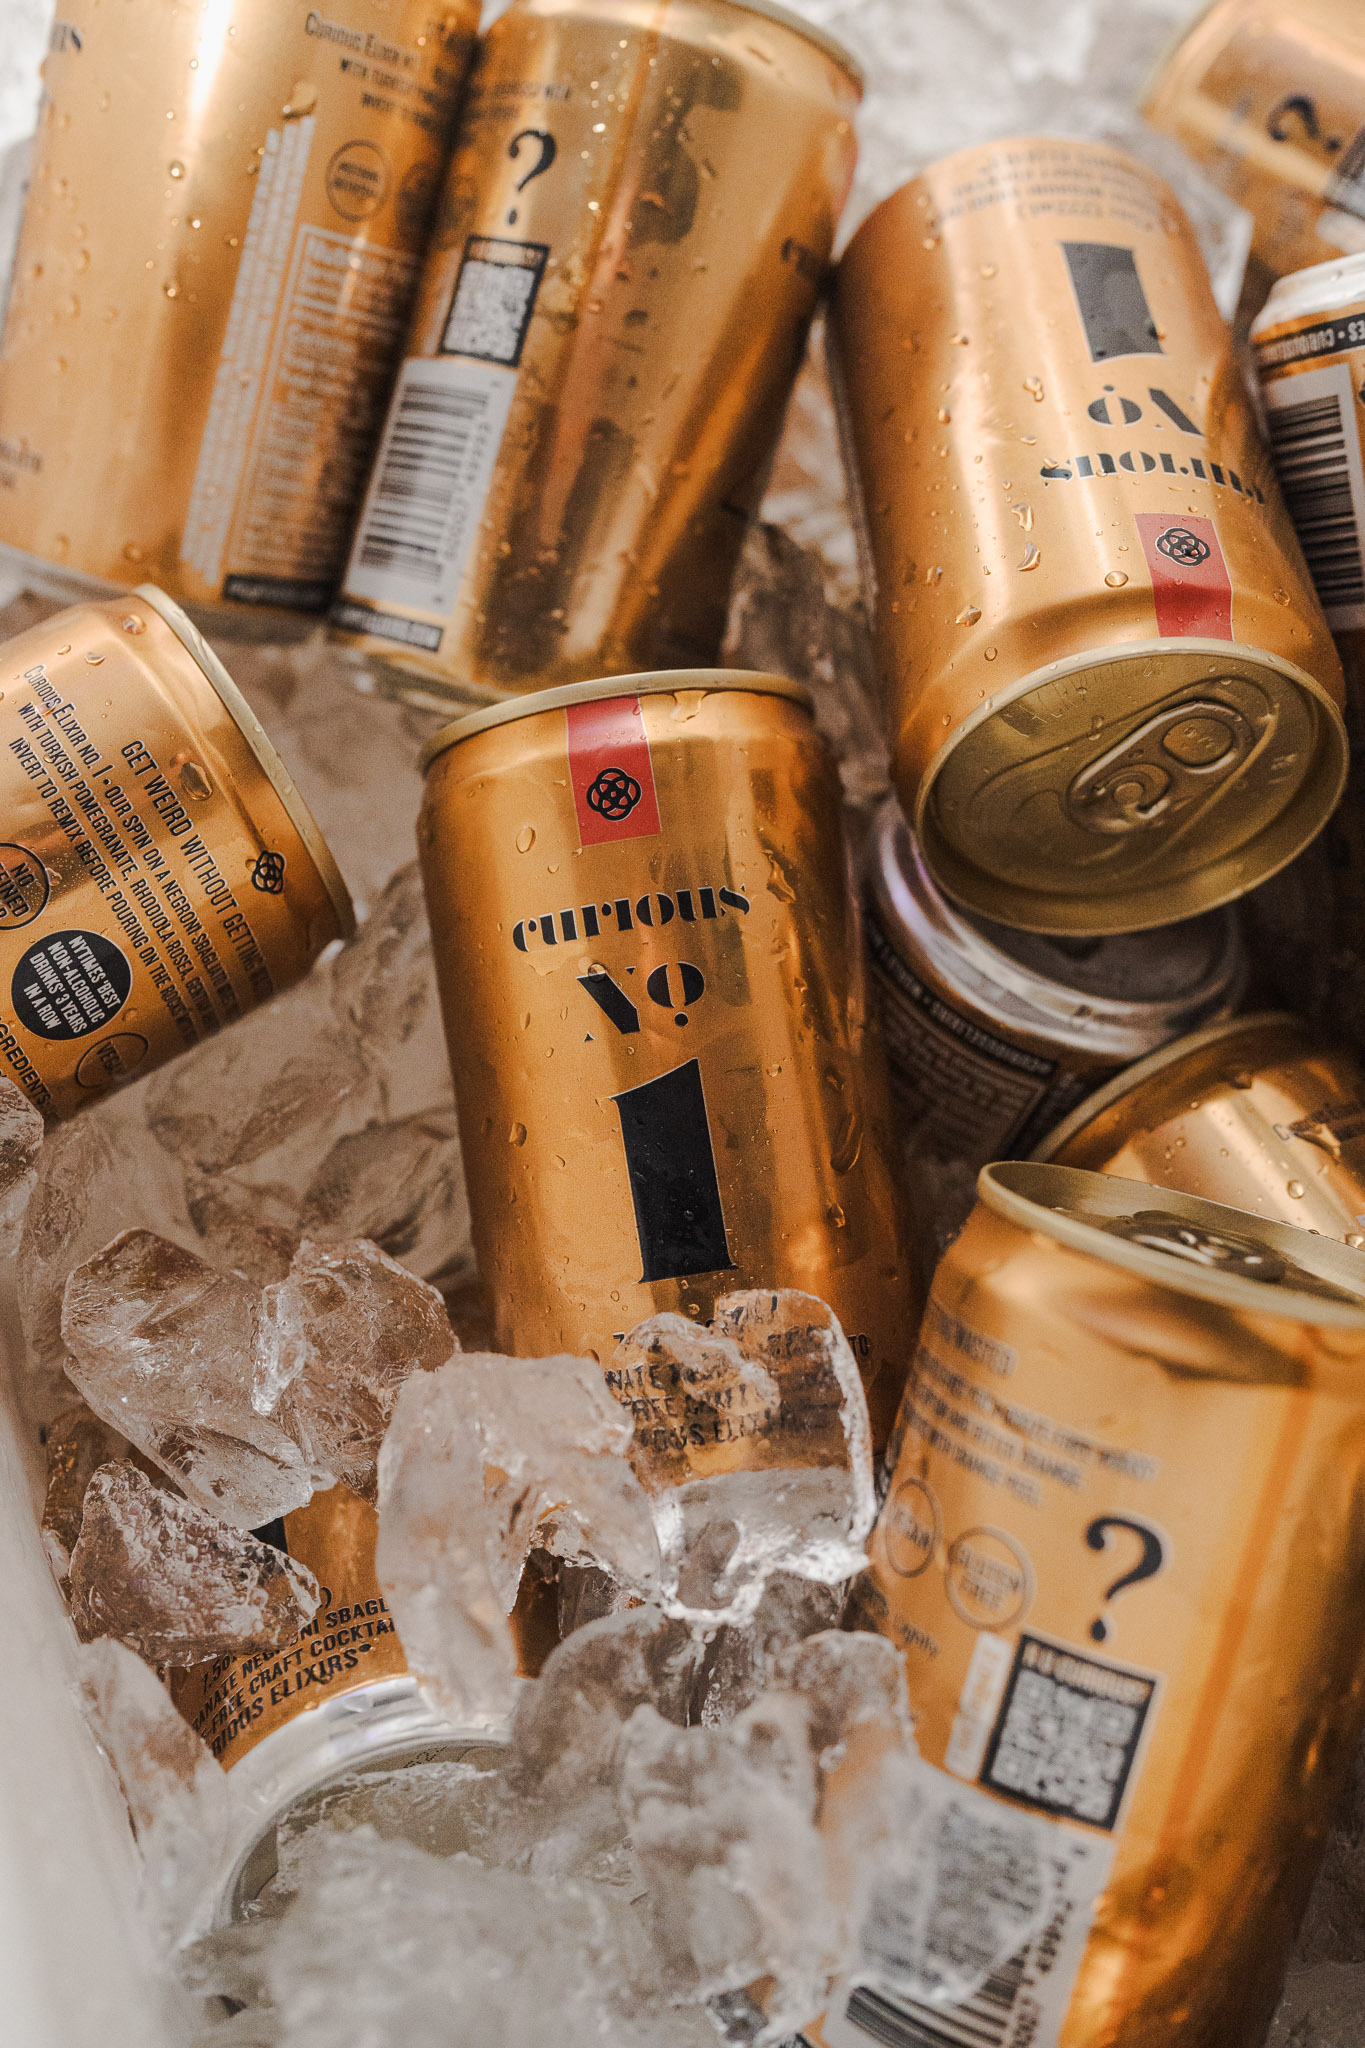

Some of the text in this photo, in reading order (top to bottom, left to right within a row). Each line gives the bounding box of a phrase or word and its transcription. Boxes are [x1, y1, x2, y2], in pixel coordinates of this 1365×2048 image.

[24, 664, 63, 710] CURIOUS
[52, 702, 89, 747] ELIXIR
[9, 736, 49, 781] INVERT
[77, 742, 101, 770] NO.
[37, 776, 60, 800] TO
[104, 785, 132, 818] OUR
[17, 702, 47, 733] WITH
[36, 728, 81, 783] TURKISH
[69, 779, 140, 882] POMEGRANATE,
[129, 877, 178, 944] RHODIOLA
[48, 796, 87, 843] REMIX
[121, 739, 158, 777] GET
[143, 773, 194, 837] WEIRD
[179, 833, 239, 915] WITHOUT
[122, 814, 154, 851] SPIN
[10, 862, 36, 887] NO
[75, 838, 119, 894] BEFORE
[142, 847, 166, 872] ON
[154, 869, 173, 883] A
[0, 862, 31, 918] FINED
[161, 879, 204, 936] NEGRONI
[105, 889, 151, 951] POURING
[512, 883, 751, 953] curious
[68, 934, 106, 984] NYTIMES
[138, 946, 160, 968] ON
[149, 962, 174, 990] THE
[47, 940, 107, 1024] NON-ALCOHOLIC
[55, 992, 70, 1007] 3
[23, 981, 62, 1030] IN A ROW
[60, 1001, 89, 1035] YEARS
[606, 1056, 739, 1285] 1
[1086, 1515, 1164, 1643] ?
[325, 1596, 389, 1629] SBAGL
[249, 1647, 304, 1696] CRAFT
[310, 1617, 396, 1658] COCKTAI
[211, 1696, 264, 1758] RIOUS
